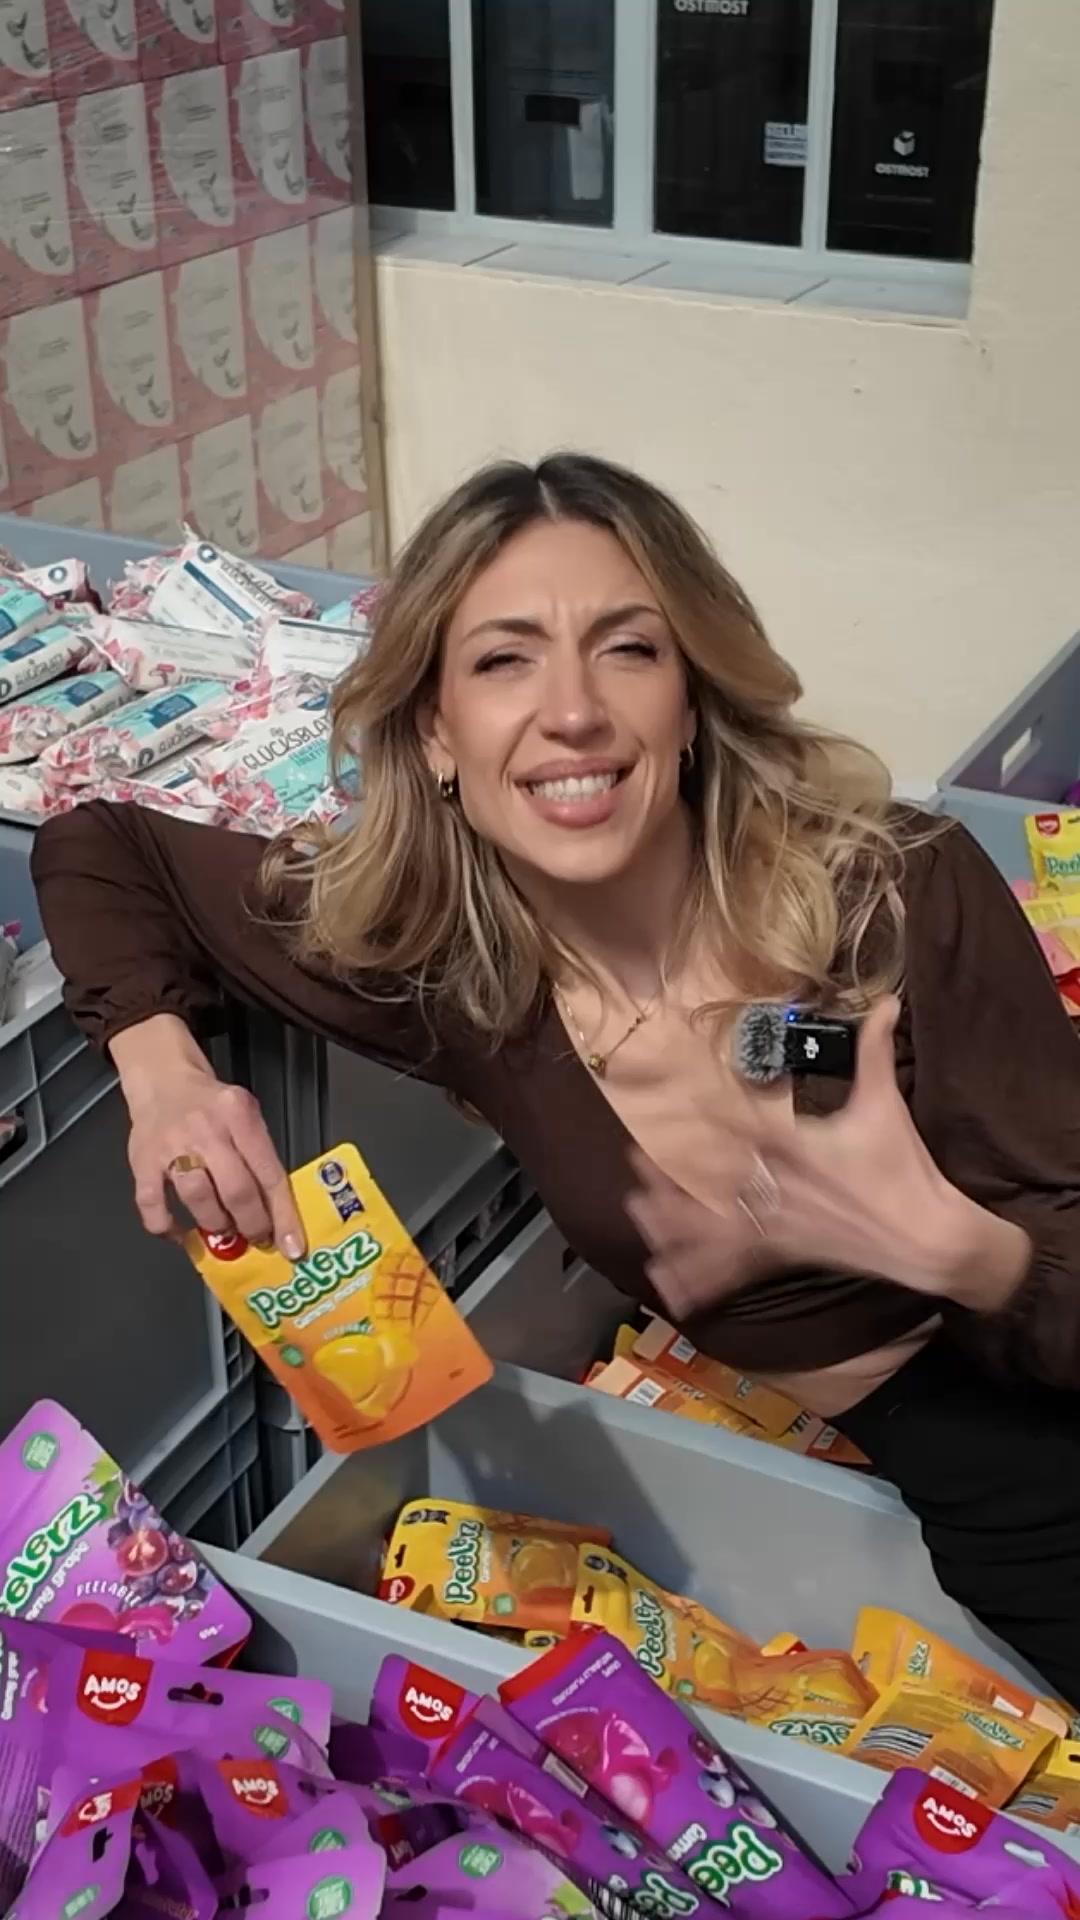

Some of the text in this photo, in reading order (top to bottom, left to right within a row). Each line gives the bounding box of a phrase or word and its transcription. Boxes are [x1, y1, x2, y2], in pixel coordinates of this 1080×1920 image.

[246, 1231, 382, 1328] Peelerz
[84, 1674, 142, 1701] AMOS
[404, 1687, 453, 1722] AMOS
[140, 1784, 175, 1809] MOS
[231, 1775, 280, 1798] AMOS
[922, 1796, 979, 1840] AMOS
[687, 1825, 783, 1909] Pee
[634, 1871, 698, 1918] Pe
